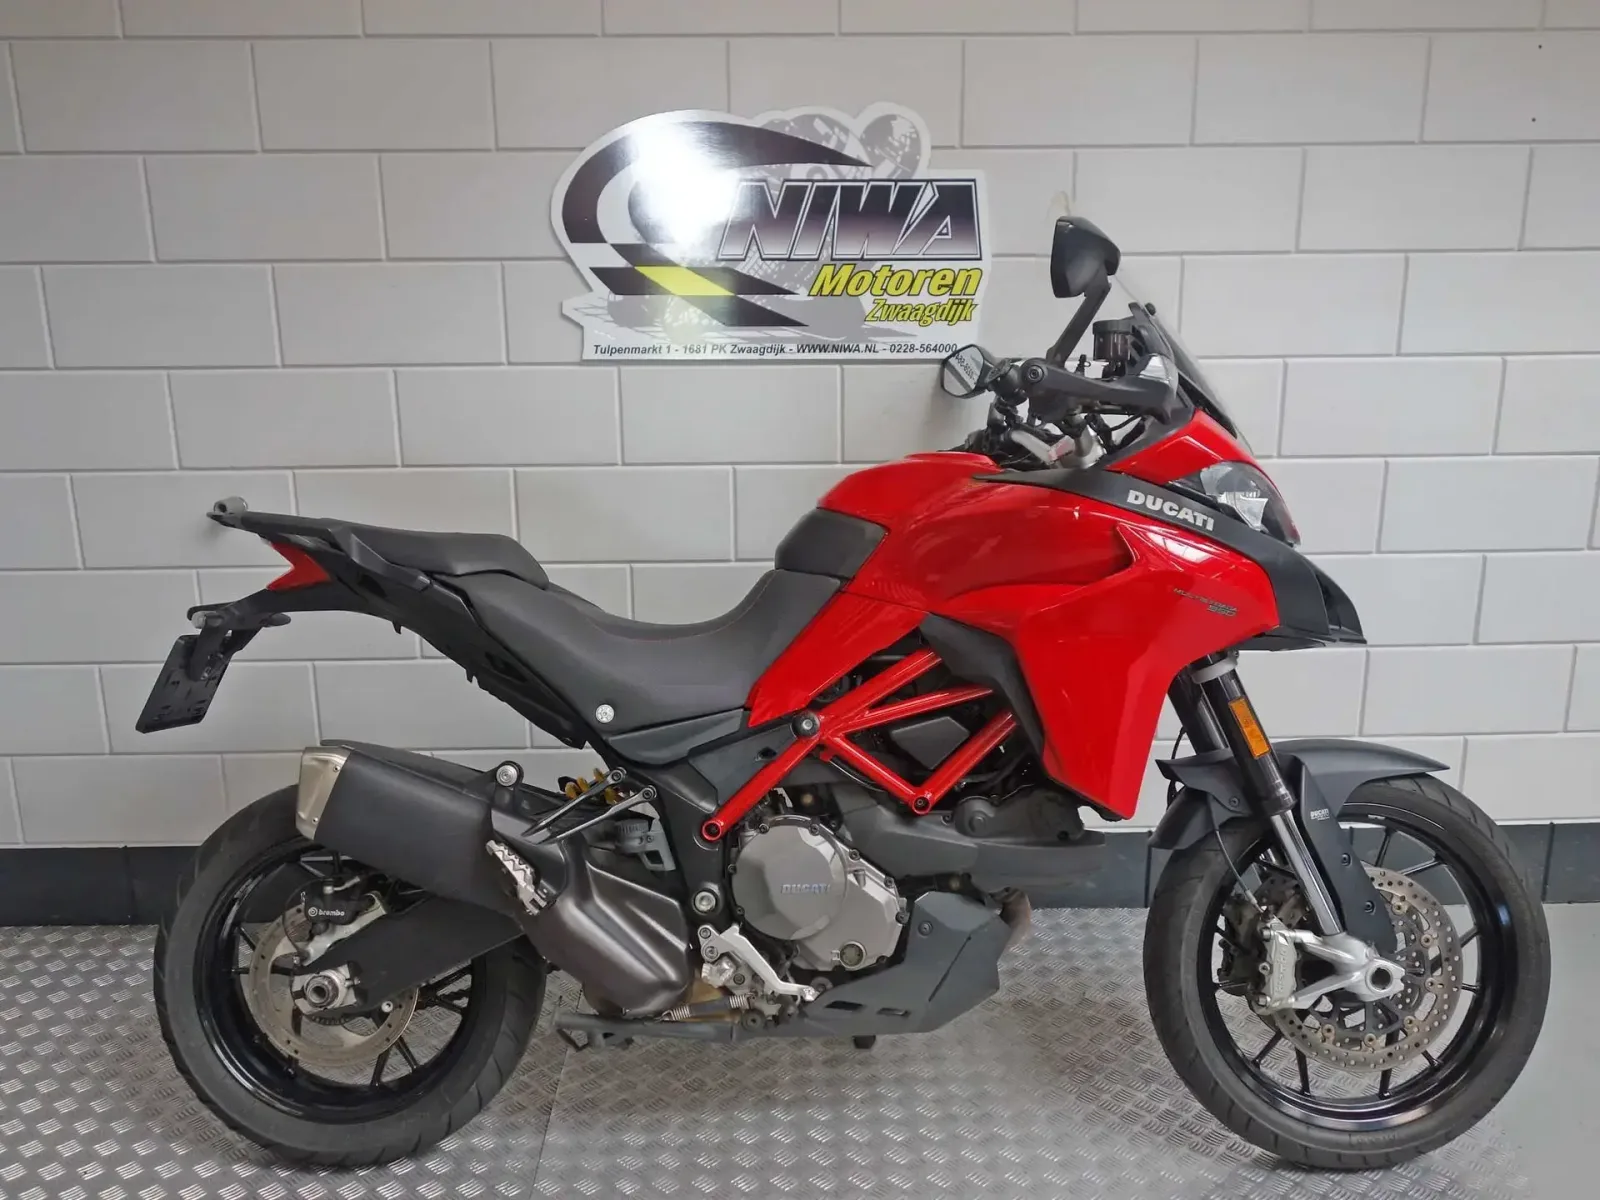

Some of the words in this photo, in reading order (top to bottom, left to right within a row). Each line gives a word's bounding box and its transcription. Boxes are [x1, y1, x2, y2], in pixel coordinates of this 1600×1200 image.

[716, 178, 983, 261] NIWA
[808, 264, 983, 297] Motoren
[865, 299, 979, 327] Zwaagdijk
[593, 344, 662, 356] Tulpenmarkt
[666, 345, 671, 354] 1
[683, 344, 707, 354] 1681
[711, 344, 727, 354] PK
[730, 344, 786, 356] Zwaagdijk
[796, 343, 879, 354] WWW.NIWA.NL
[889, 343, 958, 353] 0228-564000
[1127, 490, 1215, 531] DUCATI
[781, 883, 831, 894] DUCATI
[318, 908, 345, 916] brembo
